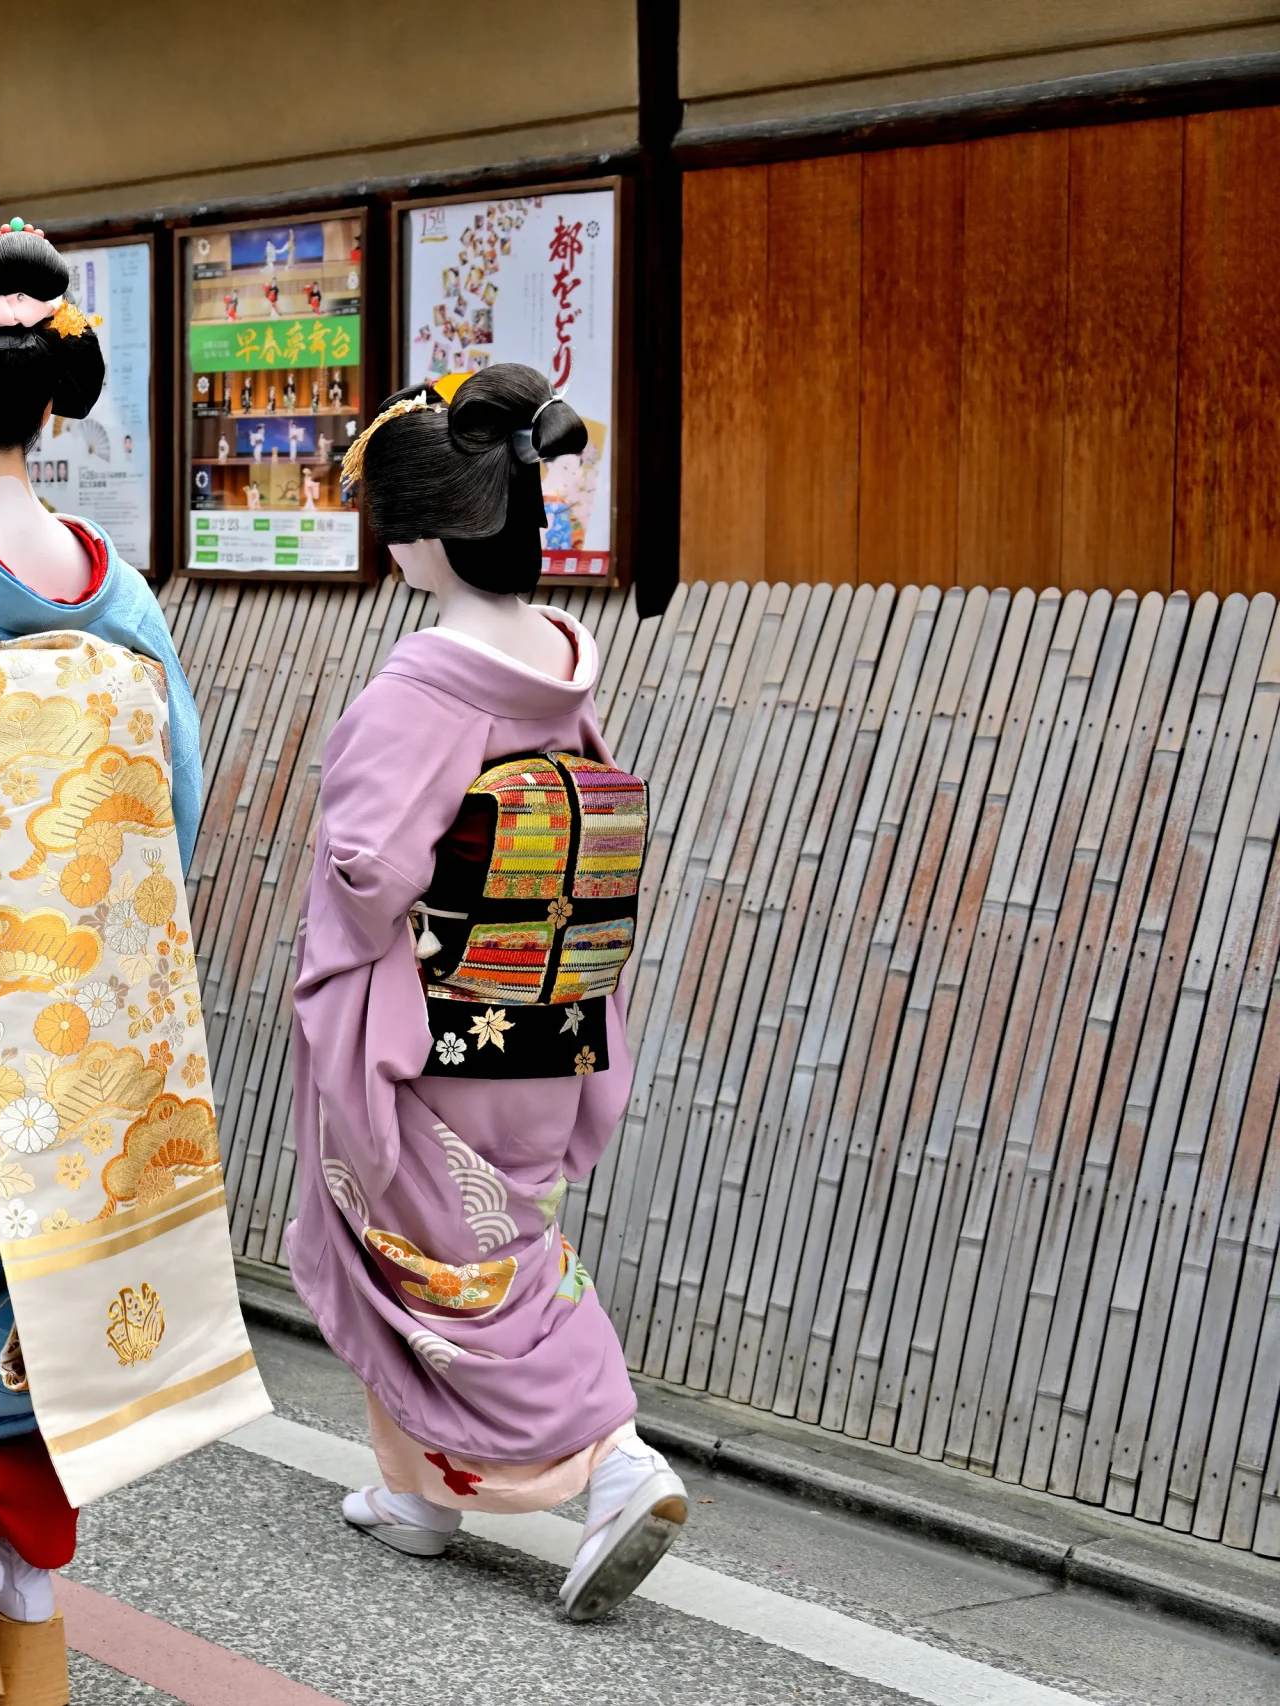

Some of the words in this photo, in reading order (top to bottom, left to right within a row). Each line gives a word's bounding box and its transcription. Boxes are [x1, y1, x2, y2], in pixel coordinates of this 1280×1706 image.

[421, 207, 445, 236] 150
[548, 215, 583, 389] 都をどり
[235, 320, 351, 368] 早春夢舞台
